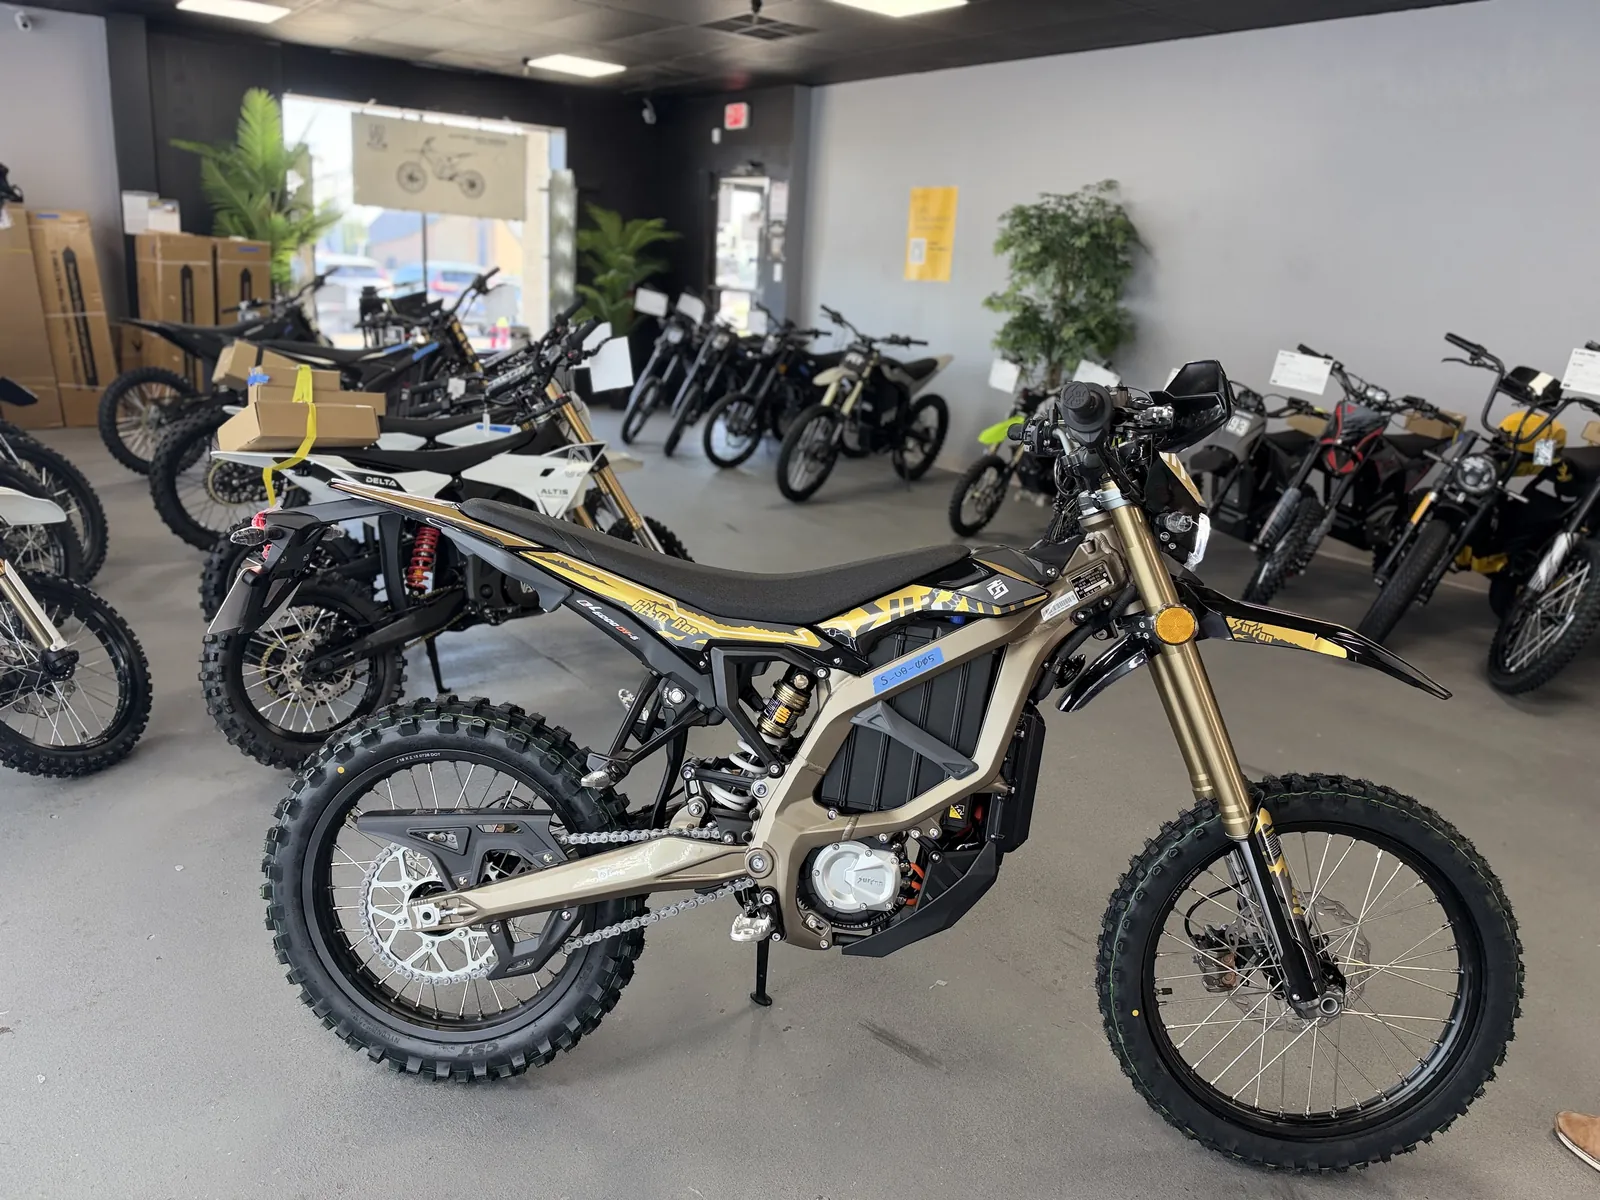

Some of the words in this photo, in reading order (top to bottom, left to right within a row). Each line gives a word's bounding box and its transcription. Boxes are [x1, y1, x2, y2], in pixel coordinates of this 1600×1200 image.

[365, 476, 397, 487] DELTA
[671, 616, 700, 637] Bee
[1230, 619, 1274, 643] Surron
